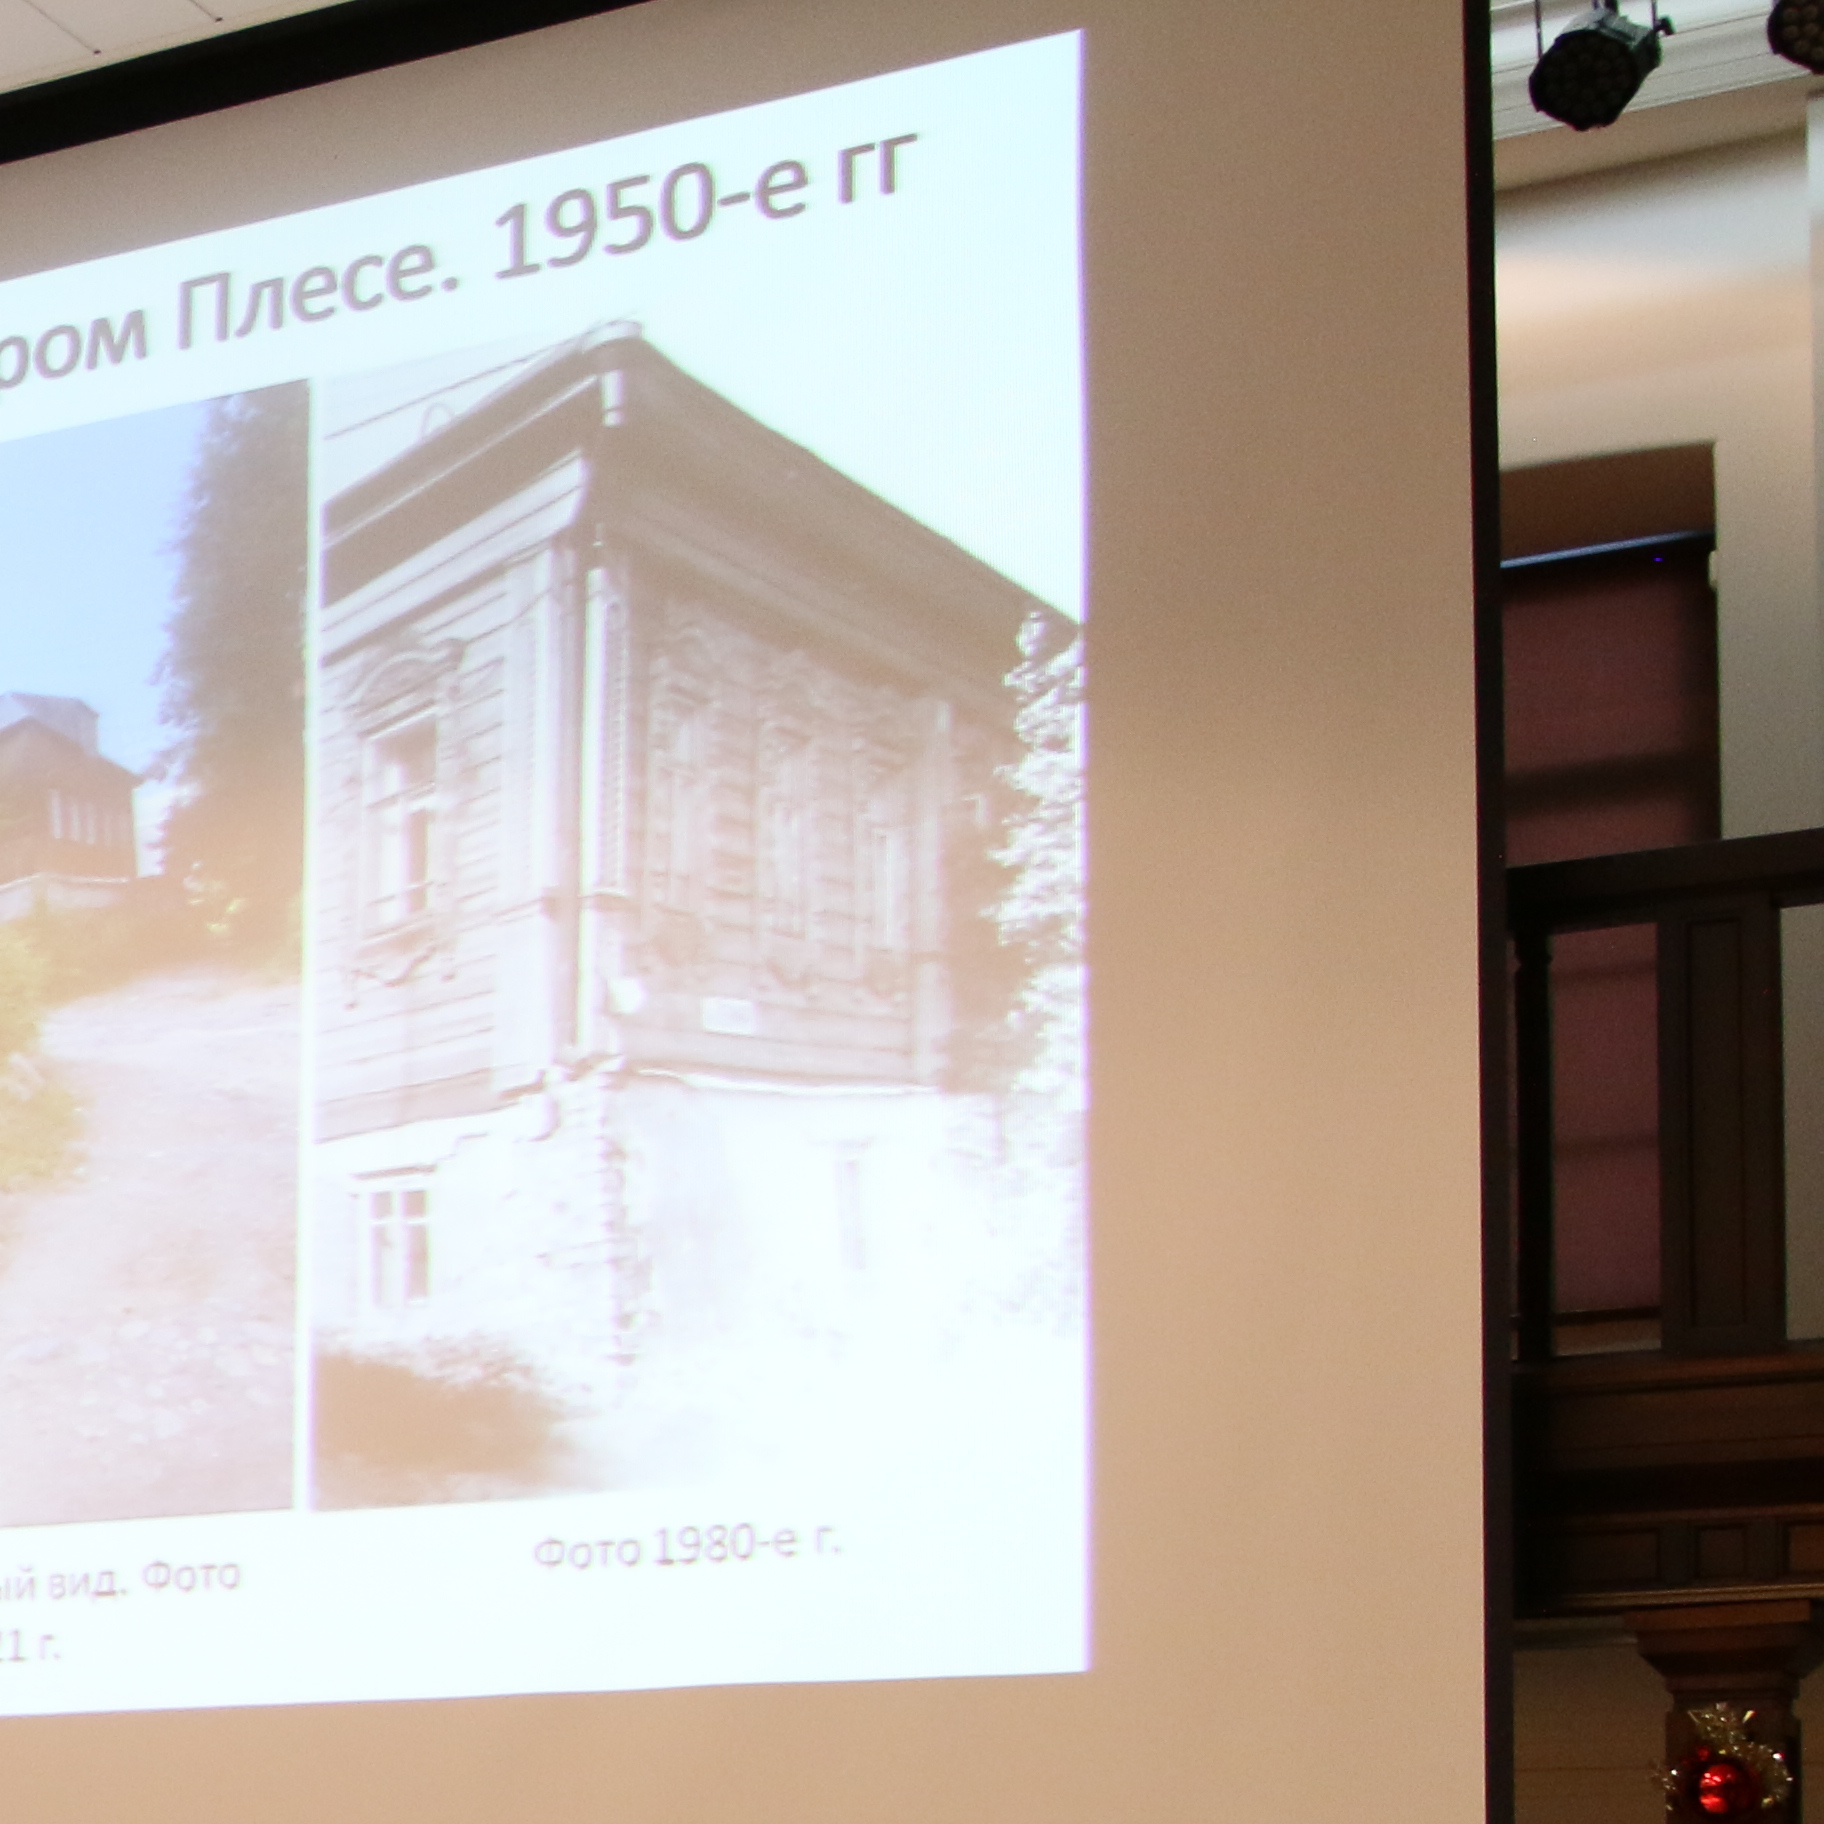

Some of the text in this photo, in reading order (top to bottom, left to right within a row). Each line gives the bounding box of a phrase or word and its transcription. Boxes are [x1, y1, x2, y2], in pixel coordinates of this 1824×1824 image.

[178, 244, 458, 350] Плесе.
[495, 159, 809, 280] 1950-е
[838, 132, 918, 205] гг
[532, 1521, 842, 1571] Фото 1980-е г.
[47, 1567, 129, 1603] вид.
[140, 1559, 241, 1594] Фото
[37, 1632, 62, 1661] г.
